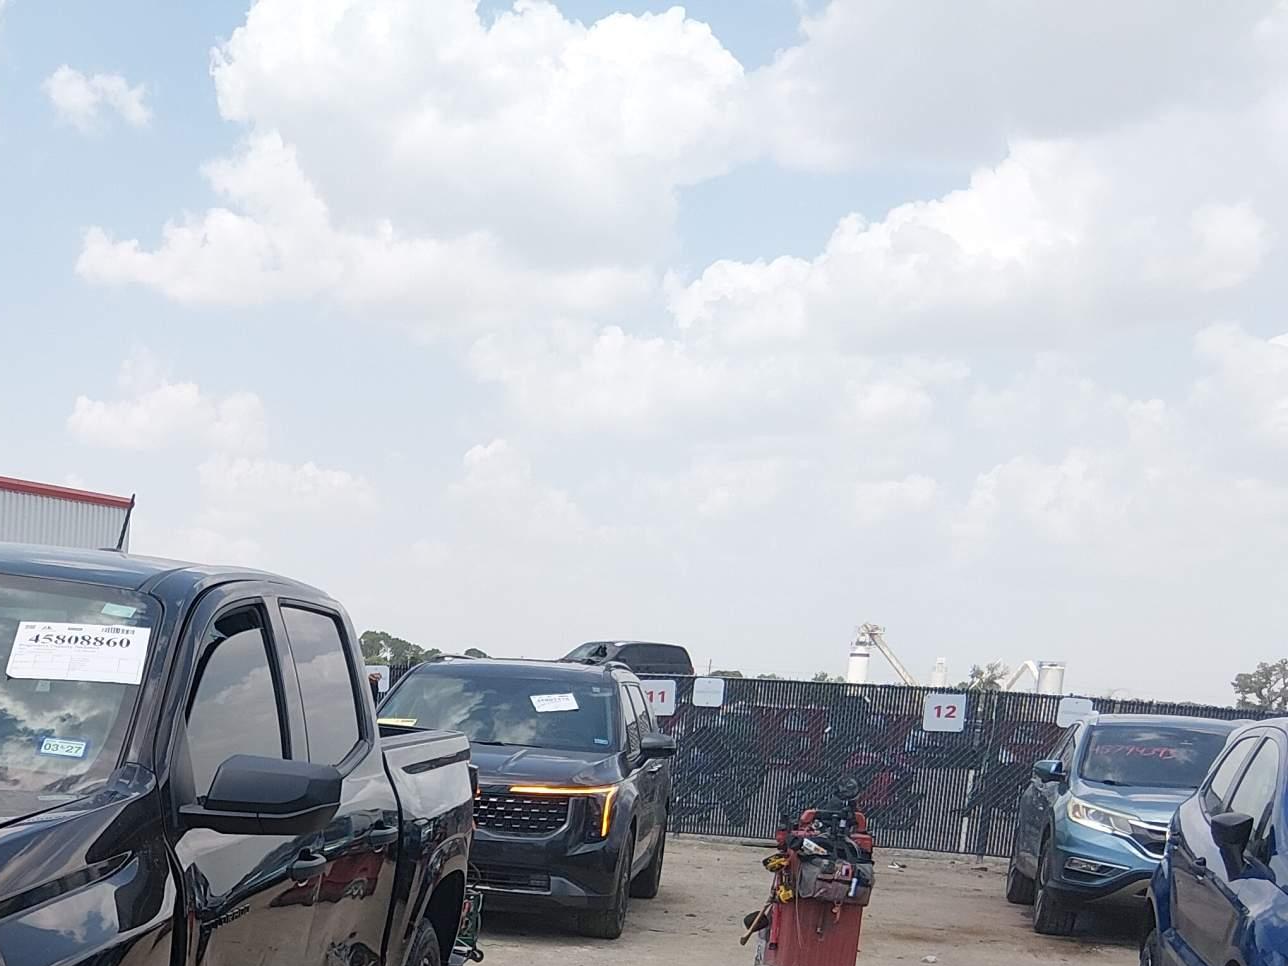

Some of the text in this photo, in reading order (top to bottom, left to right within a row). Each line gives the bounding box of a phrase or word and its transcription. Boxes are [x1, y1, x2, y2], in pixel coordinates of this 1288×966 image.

[28, 633, 131, 648] 45808860
[647, 690, 665, 703] 11
[934, 705, 957, 718] 12
[44, 743, 82, 753] 03 27
